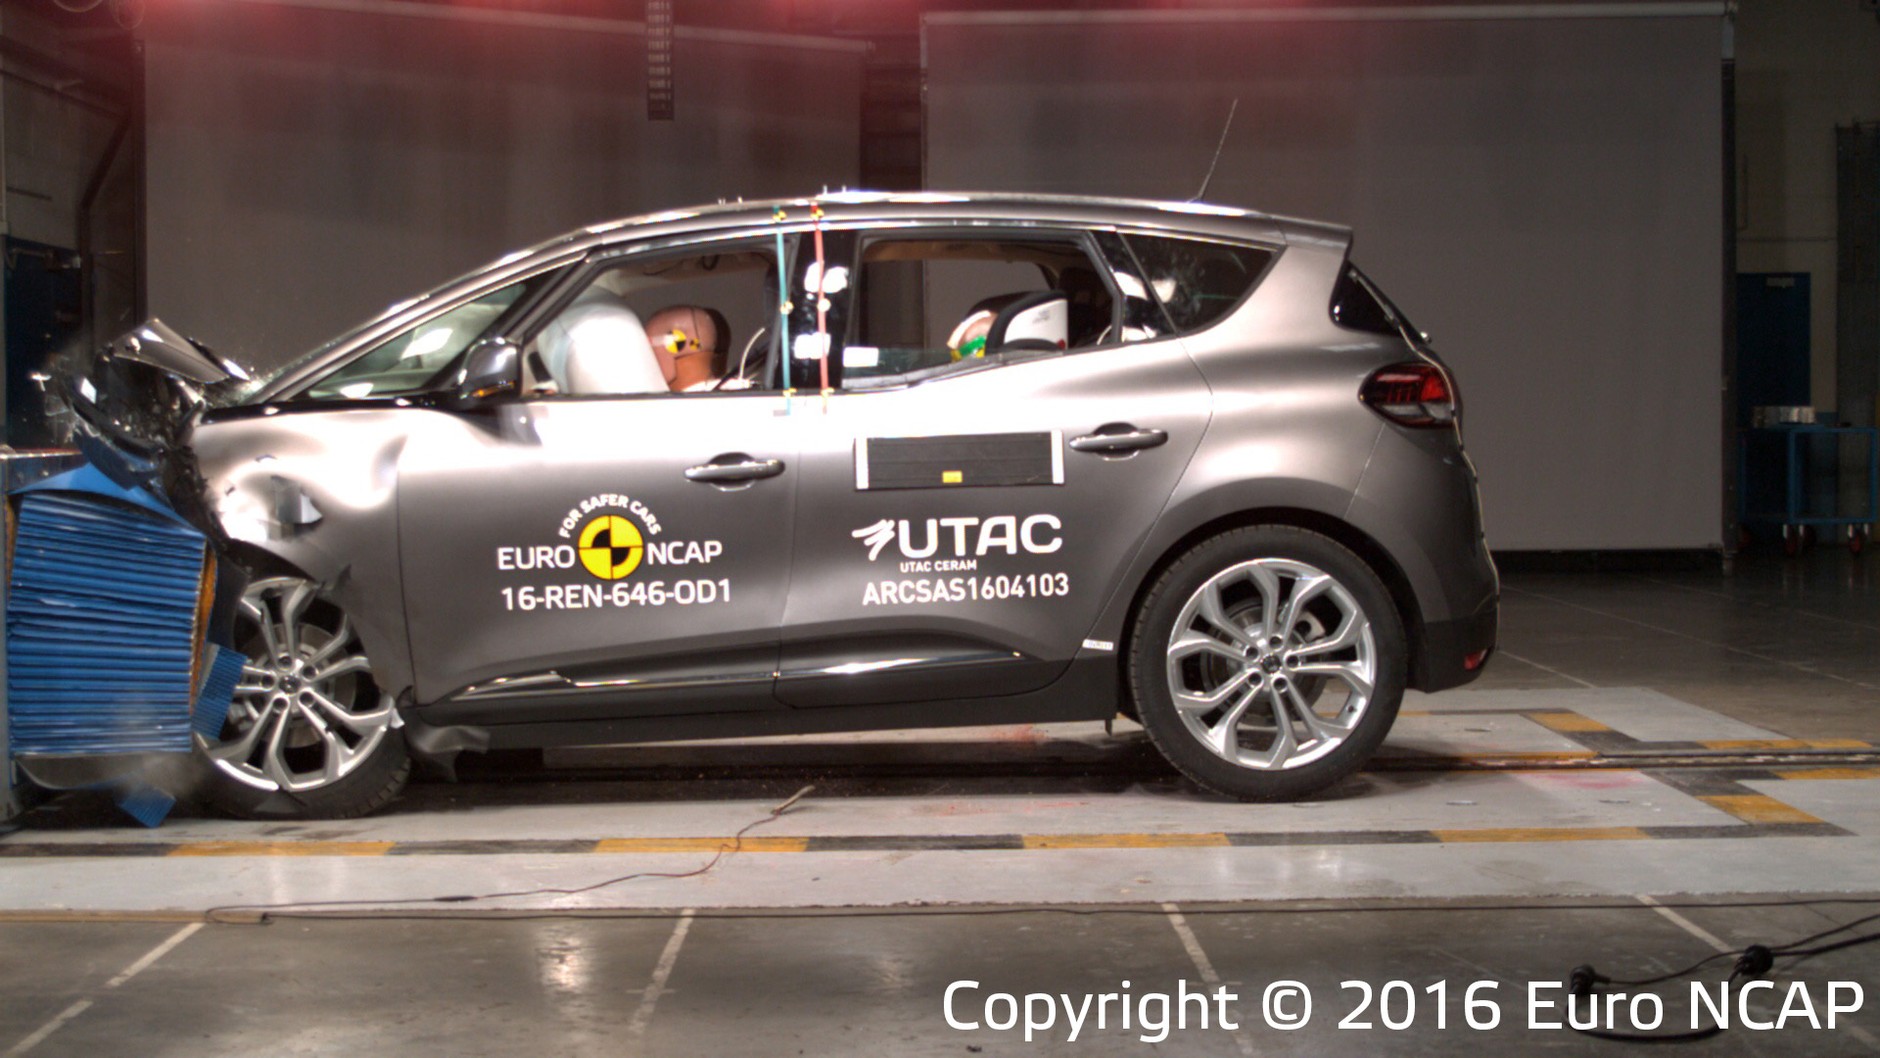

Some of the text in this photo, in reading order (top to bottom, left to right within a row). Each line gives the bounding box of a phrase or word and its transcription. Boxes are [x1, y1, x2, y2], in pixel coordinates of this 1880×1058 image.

[559, 493, 662, 539] FOR SAFER CARS
[899, 513, 1063, 559] UTAC
[497, 540, 723, 570] EURO NCAP
[900, 559, 977, 574] UTAC CERAM
[862, 572, 1070, 606] ARCSAS1604103
